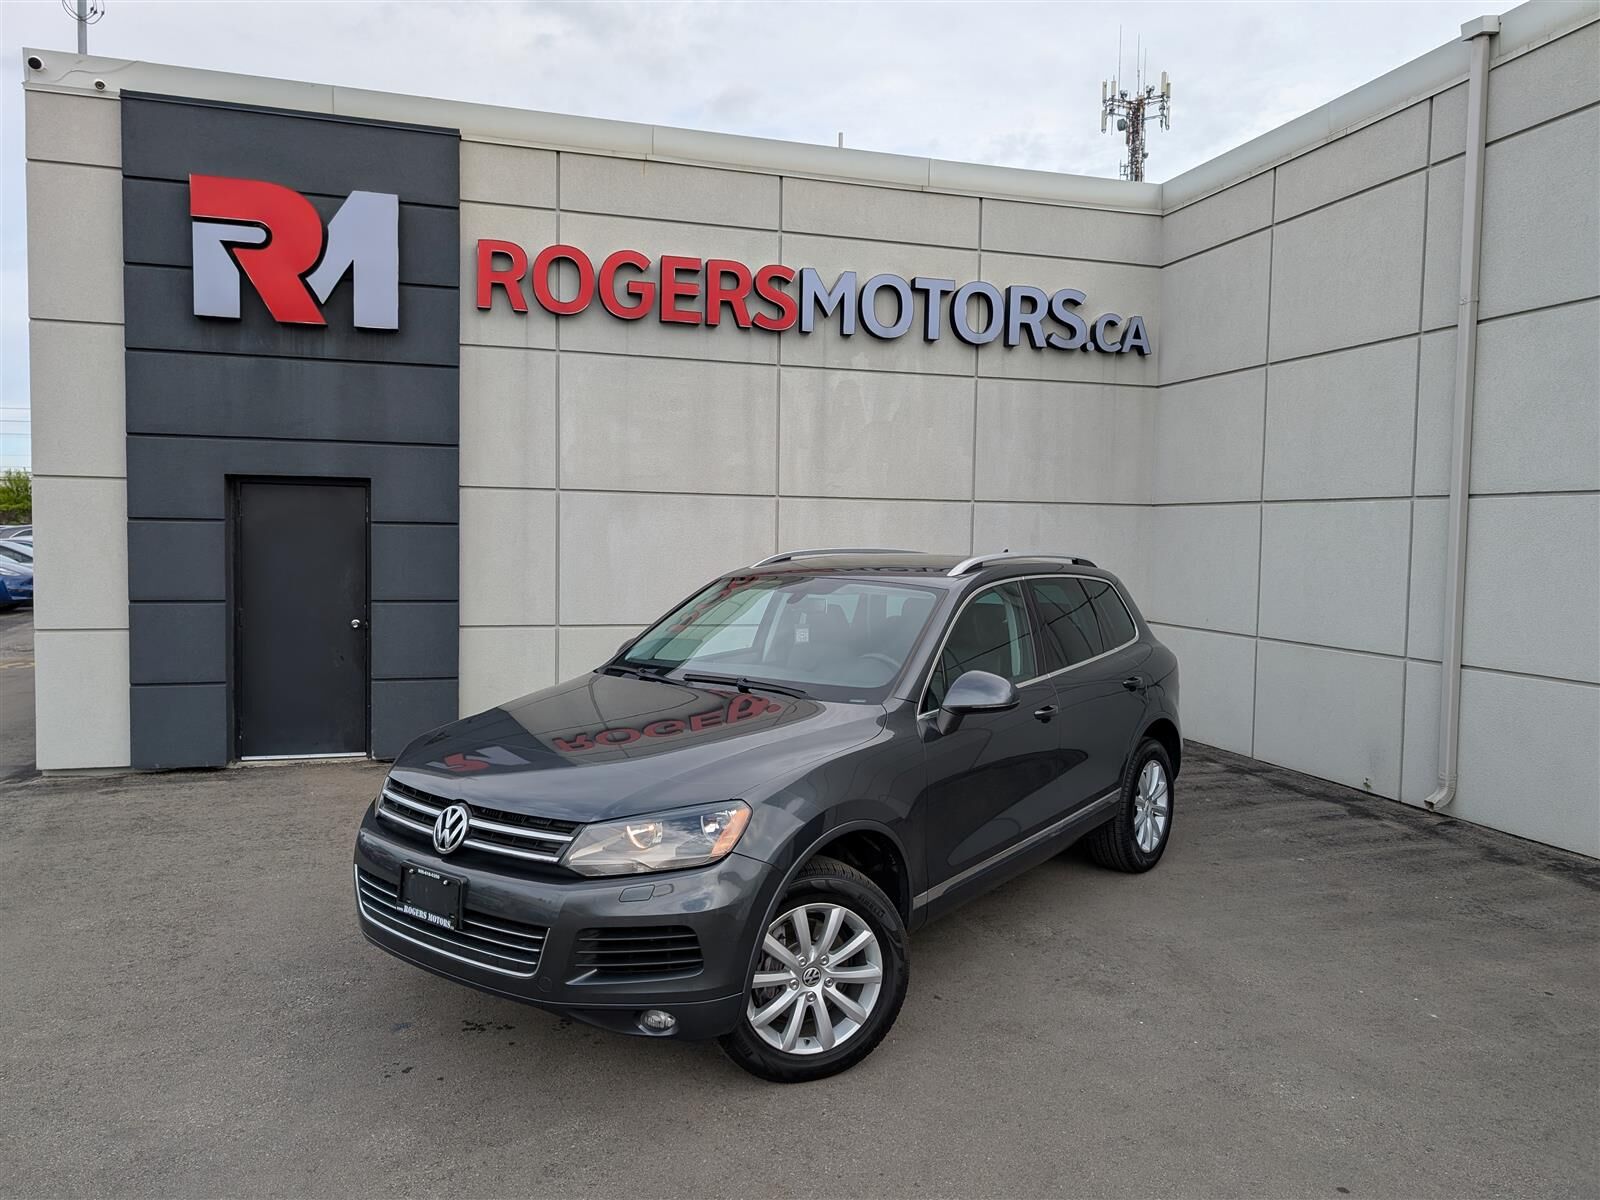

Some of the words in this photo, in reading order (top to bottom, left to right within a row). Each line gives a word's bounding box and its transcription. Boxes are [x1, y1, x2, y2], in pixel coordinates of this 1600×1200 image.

[189, 173, 399, 330] RM
[476, 238, 1152, 356] ROGERSMOTORS.CA
[403, 905, 427, 920] ROGERS
